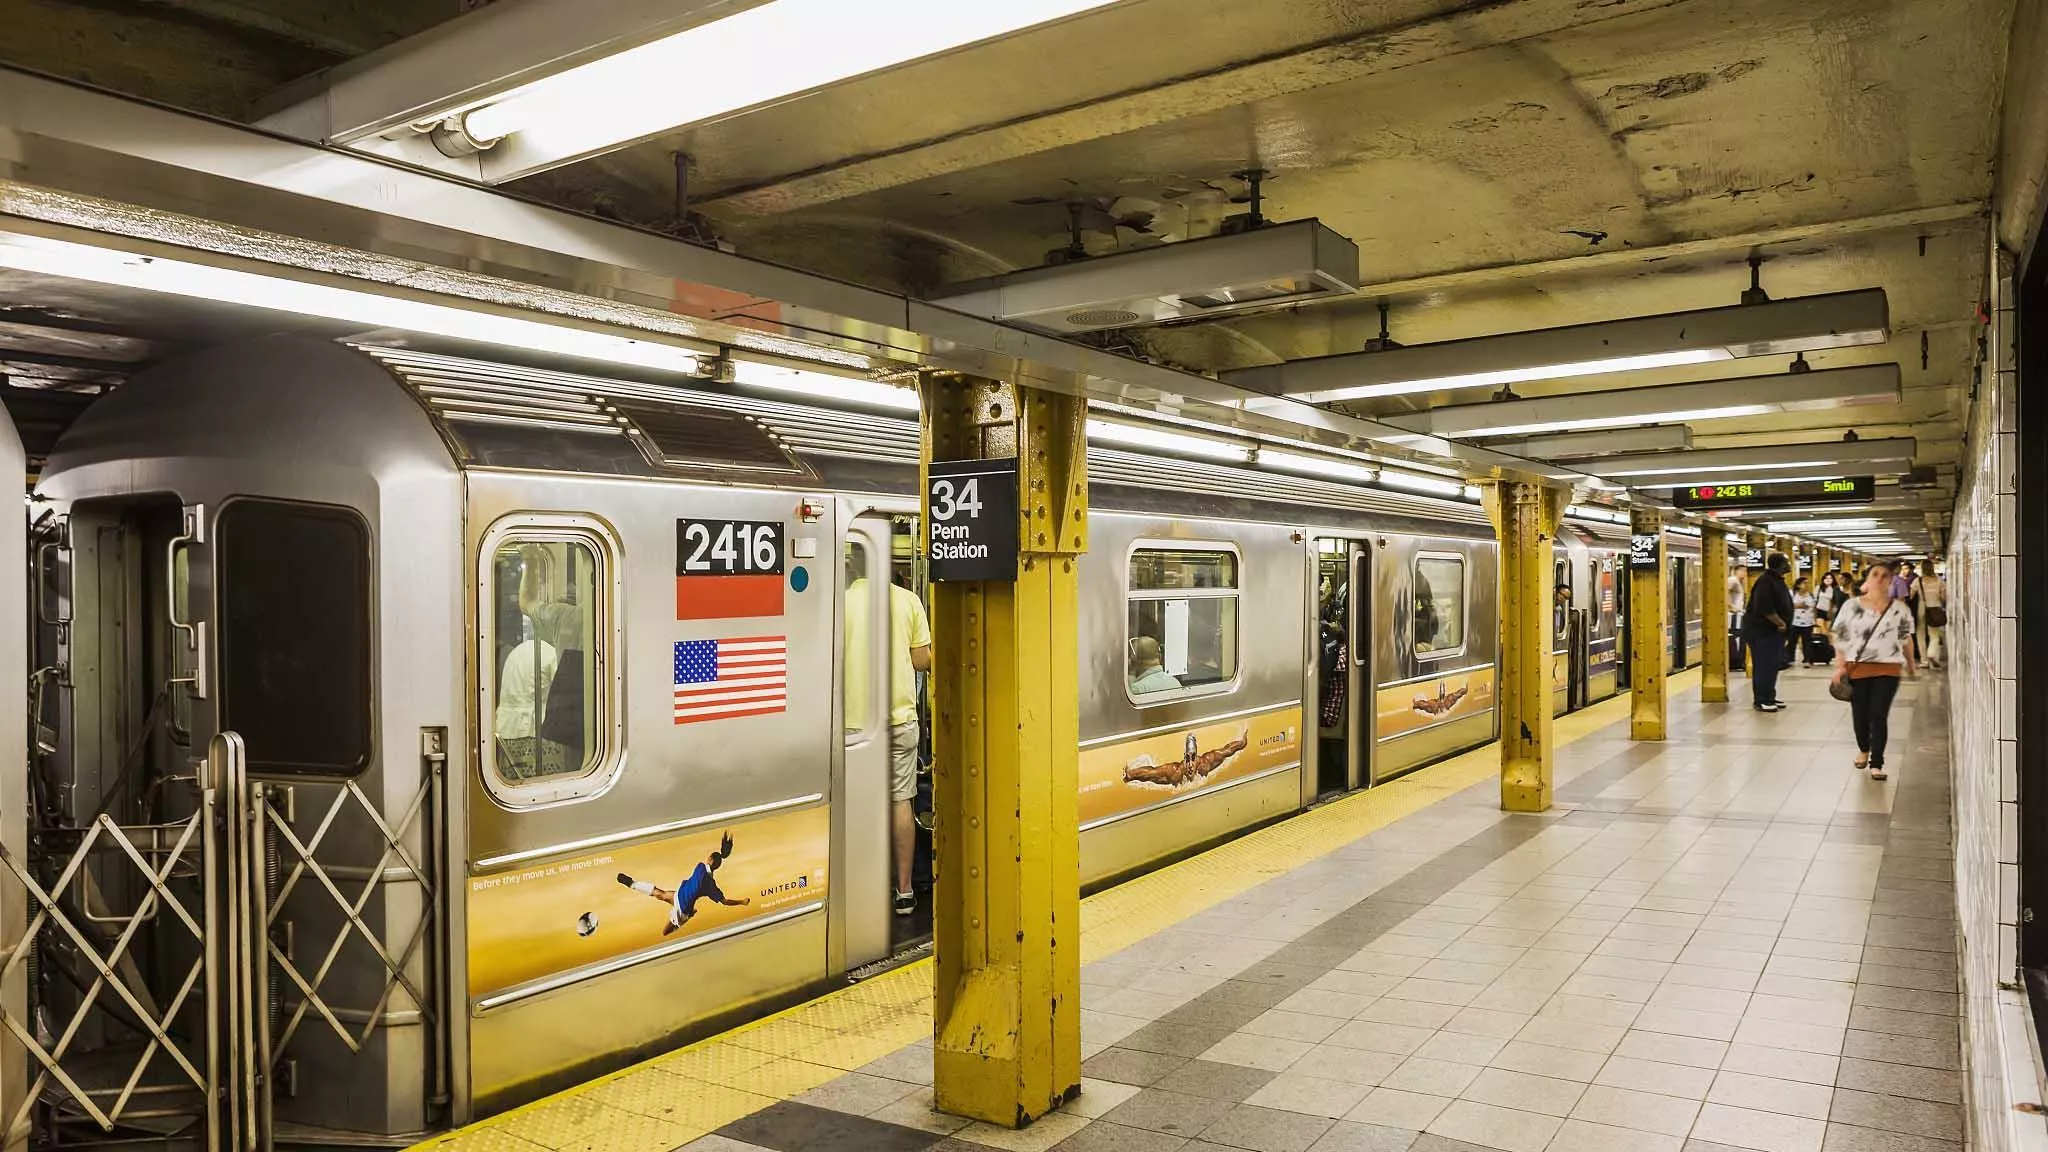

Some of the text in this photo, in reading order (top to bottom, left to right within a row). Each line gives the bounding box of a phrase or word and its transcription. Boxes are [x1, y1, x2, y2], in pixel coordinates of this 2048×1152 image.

[1717, 486, 1737, 497] 242
[1739, 485, 1752, 496] St
[1824, 481, 1854, 492] 5min
[931, 478, 983, 520] 34
[931, 522, 970, 540] Penn
[685, 523, 777, 570] 2416
[931, 541, 988, 560] Station
[1632, 537, 1654, 551] 34
[1259, 735, 1280, 746] UNITED
[473, 878, 500, 891] Before
[502, 873, 520, 885] they
[522, 869, 544, 880] move
[558, 864, 570, 873] we
[571, 860, 592, 871] move
[761, 881, 797, 897] UNITED
